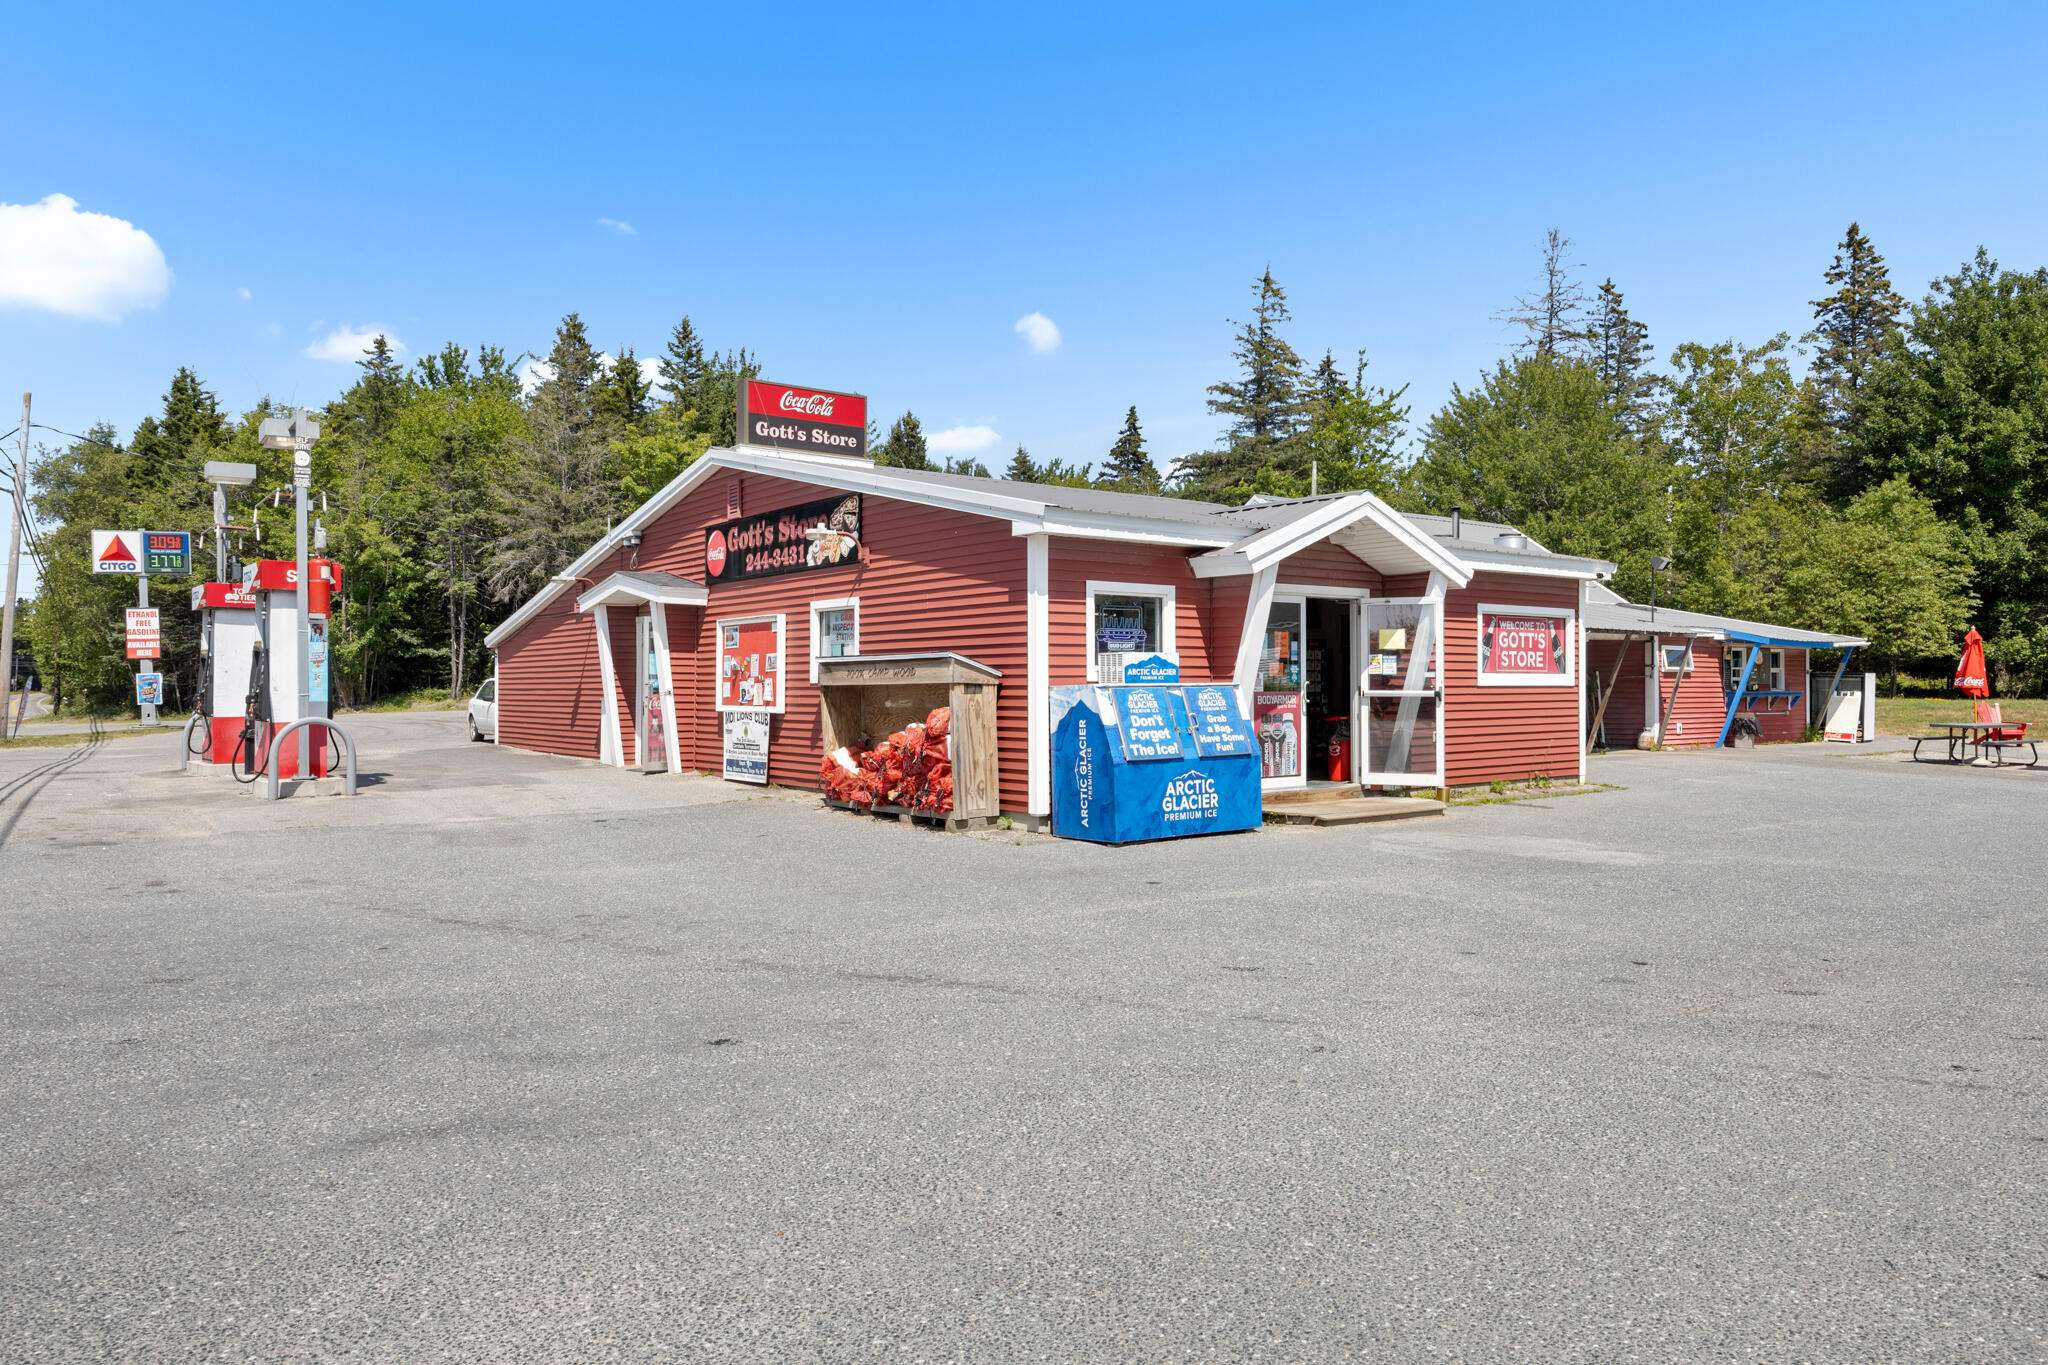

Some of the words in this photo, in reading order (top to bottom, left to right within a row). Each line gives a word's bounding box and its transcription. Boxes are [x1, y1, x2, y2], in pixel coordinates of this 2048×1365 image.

[780, 391, 835, 416] Coca-Cola
[755, 421, 807, 441] Gott's
[811, 428, 857, 448] Store
[727, 519, 774, 552] Gott's
[746, 544, 805, 572] 244-3431
[100, 562, 136, 570] CITGO
[833, 623, 854, 632] INSPECT
[1499, 621, 1534, 630] WELCOME
[1535, 622, 1546, 631] TO
[836, 632, 854, 640] STATIO
[1498, 631, 1546, 649] GOTT'S
[1501, 650, 1544, 667] STORE
[868, 667, 889, 678] CAMP
[893, 667, 917, 678] WOOD
[1127, 668, 1150, 676] ARCTIC
[1128, 693, 1155, 701] ARCTIC
[1198, 699, 1226, 707] GLACIER
[1257, 695, 1297, 704] BODYARMOR
[1128, 700, 1158, 709] GLACIER
[725, 712, 735, 724] MDI
[736, 712, 752, 721] LIONS
[754, 712, 768, 726] CLUB
[1130, 714, 1164, 727] Don't
[1206, 714, 1227, 723] Grab
[1129, 728, 1171, 743] Forget
[1213, 724, 1233, 734] Bag.
[1199, 734, 1221, 743] Have
[1222, 733, 1245, 742] Some
[1079, 719, 1087, 775] GLACIER
[1130, 743, 1155, 756] The
[1156, 742, 1179, 754] Ice!
[1216, 743, 1234, 751] Fun!
[1165, 778, 1215, 796] ARCTIC
[1080, 778, 1089, 828] ARCTIC
[1162, 793, 1219, 812] GLACIER
[1164, 811, 1202, 822] PREMIUM
[1204, 809, 1218, 818] ICE
